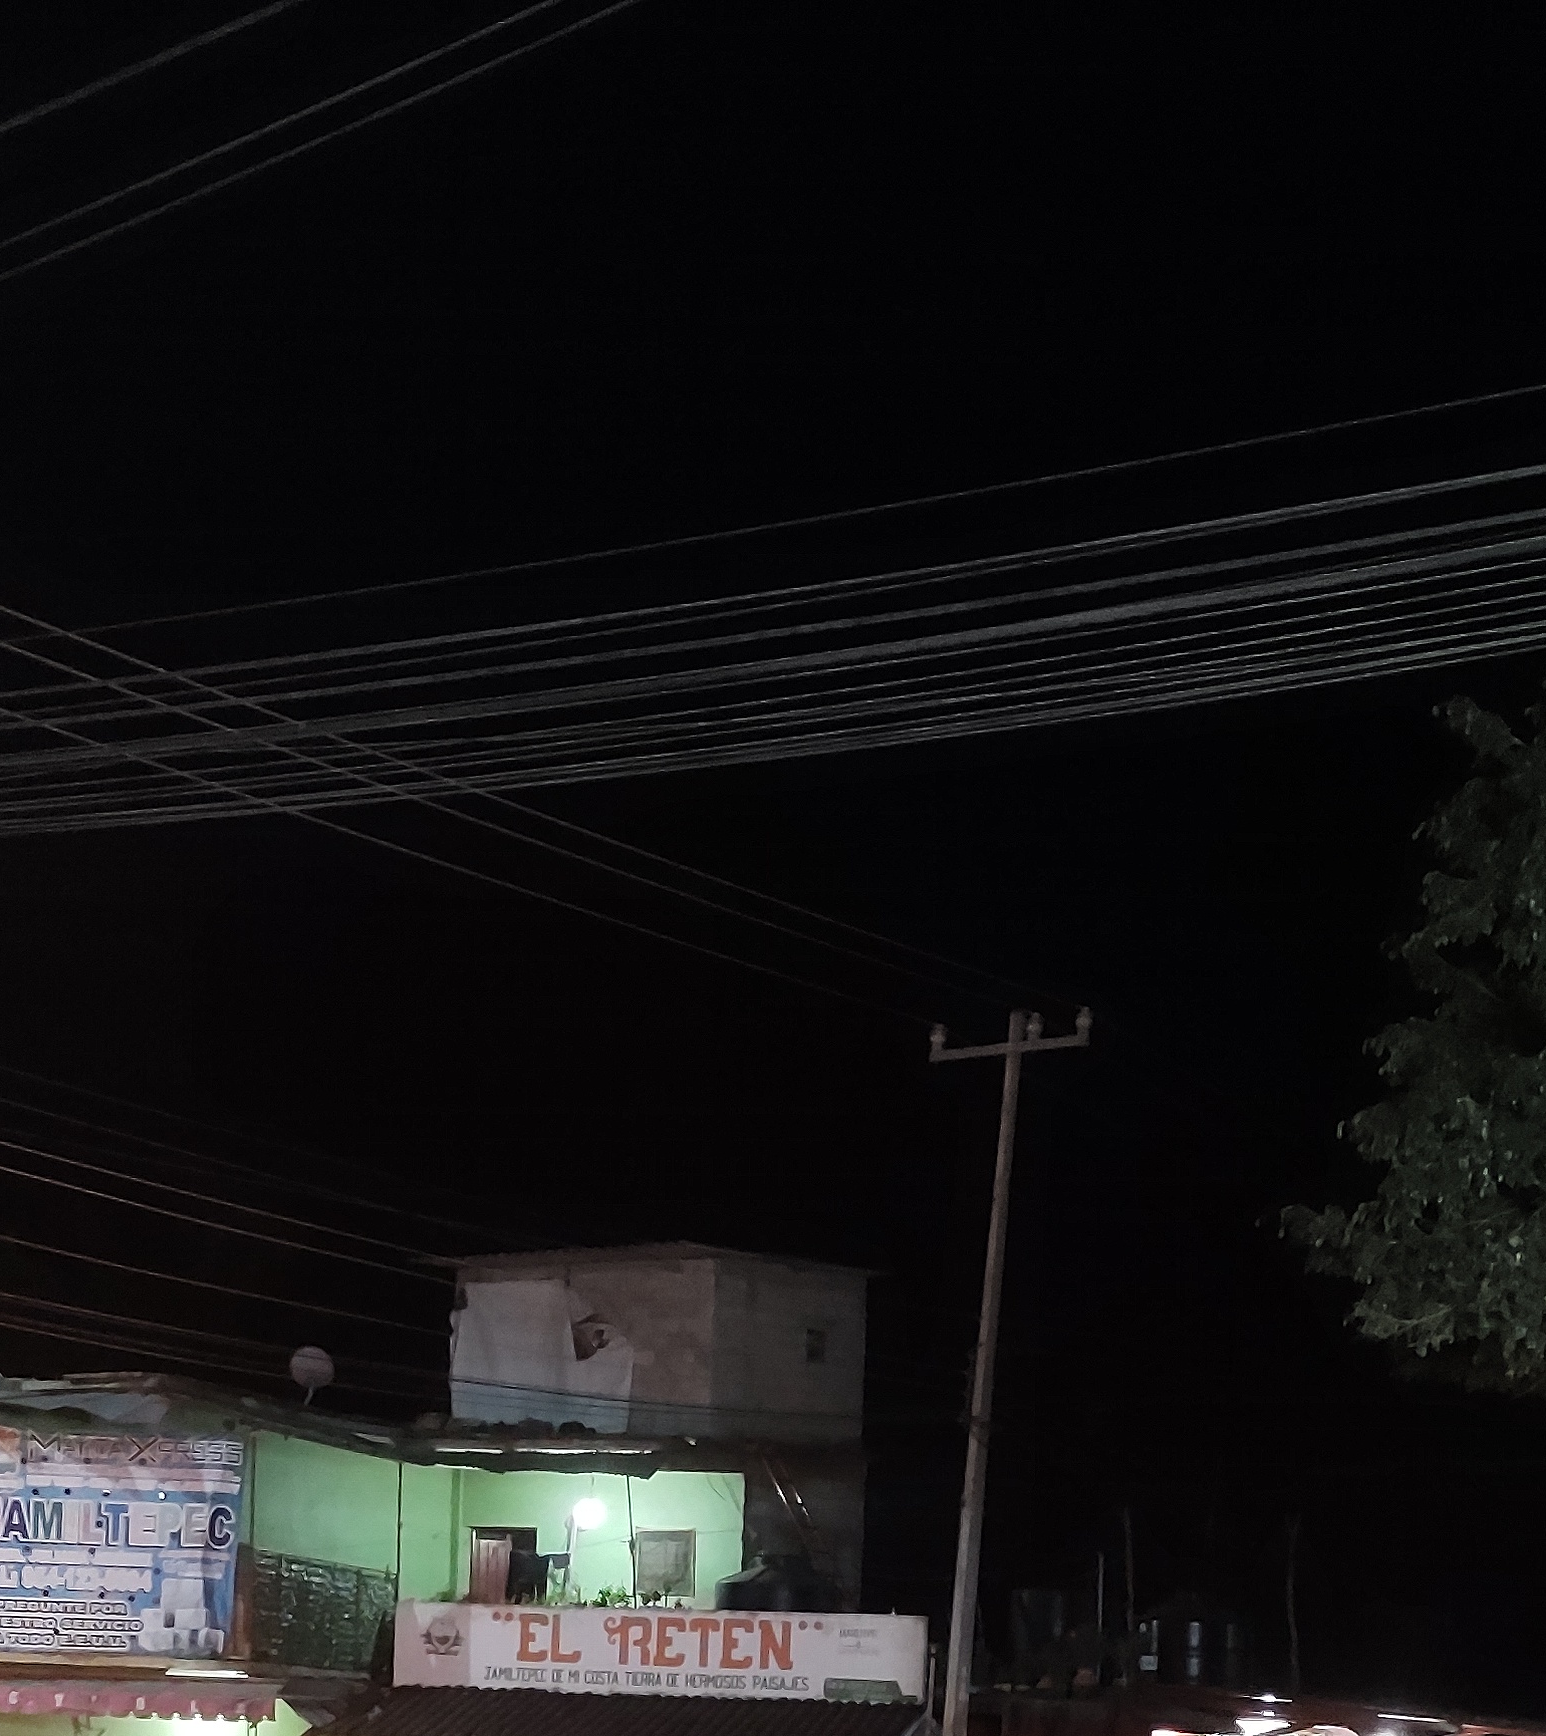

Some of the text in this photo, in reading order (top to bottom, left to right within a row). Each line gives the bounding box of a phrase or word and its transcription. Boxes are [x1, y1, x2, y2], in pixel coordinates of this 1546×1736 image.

[89, 1602, 128, 1616] POR
[59, 1617, 144, 1632] SERVICIO
[7, 1632, 54, 1646] TODO
[484, 1666, 810, 1692] JAMILTEPEC DE MI COSTA TIERRA DE HERMOSOS PAISAJES
